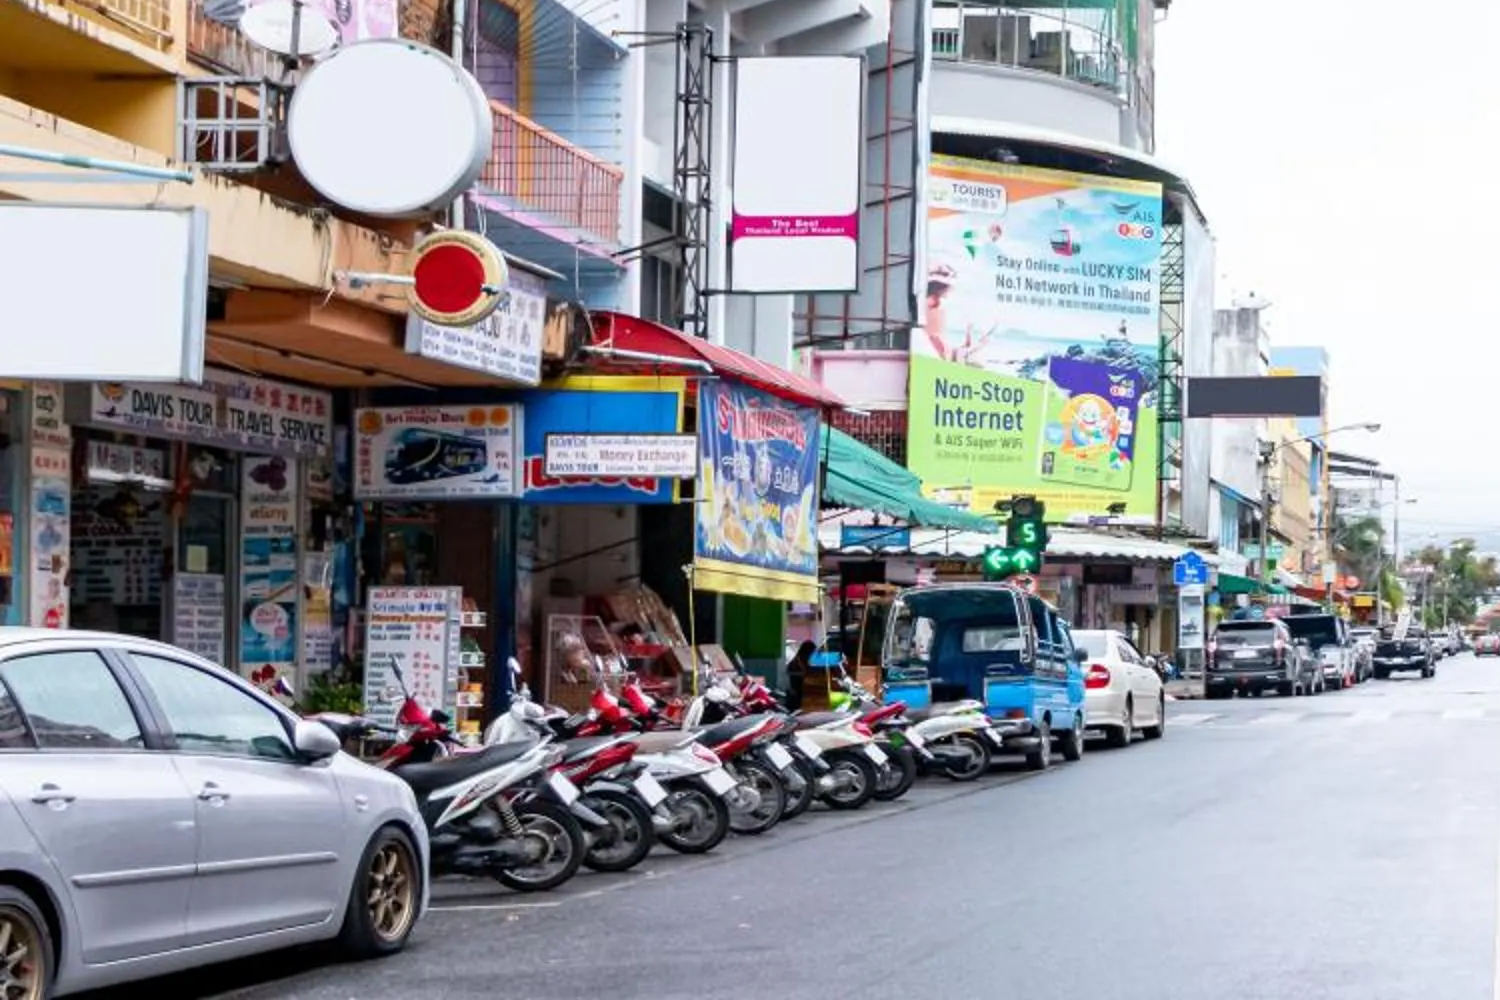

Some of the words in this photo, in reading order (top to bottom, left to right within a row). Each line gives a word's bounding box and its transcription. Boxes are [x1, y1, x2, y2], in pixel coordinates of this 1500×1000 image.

[952, 182, 1002, 199] TOURIST
[997, 255, 1021, 271] Stay
[1025, 257, 1060, 273] Online
[1081, 262, 1124, 280] LUCKY
[1127, 266, 1151, 283] SIM
[995, 274, 1021, 290] No.1
[1025, 278, 1079, 295] Network
[1083, 281, 1095, 297] in
[1099, 284, 1151, 302] Thailand
[935, 377, 1025, 408] Non-Stop
[131, 388, 175, 420] DAVIS
[179, 397, 213, 428] TOUR
[229, 406, 276, 437] TRAVEL
[280, 416, 325, 445] SERVICE
[934, 403, 1024, 431] Internet
[965, 434, 997, 451] Super
